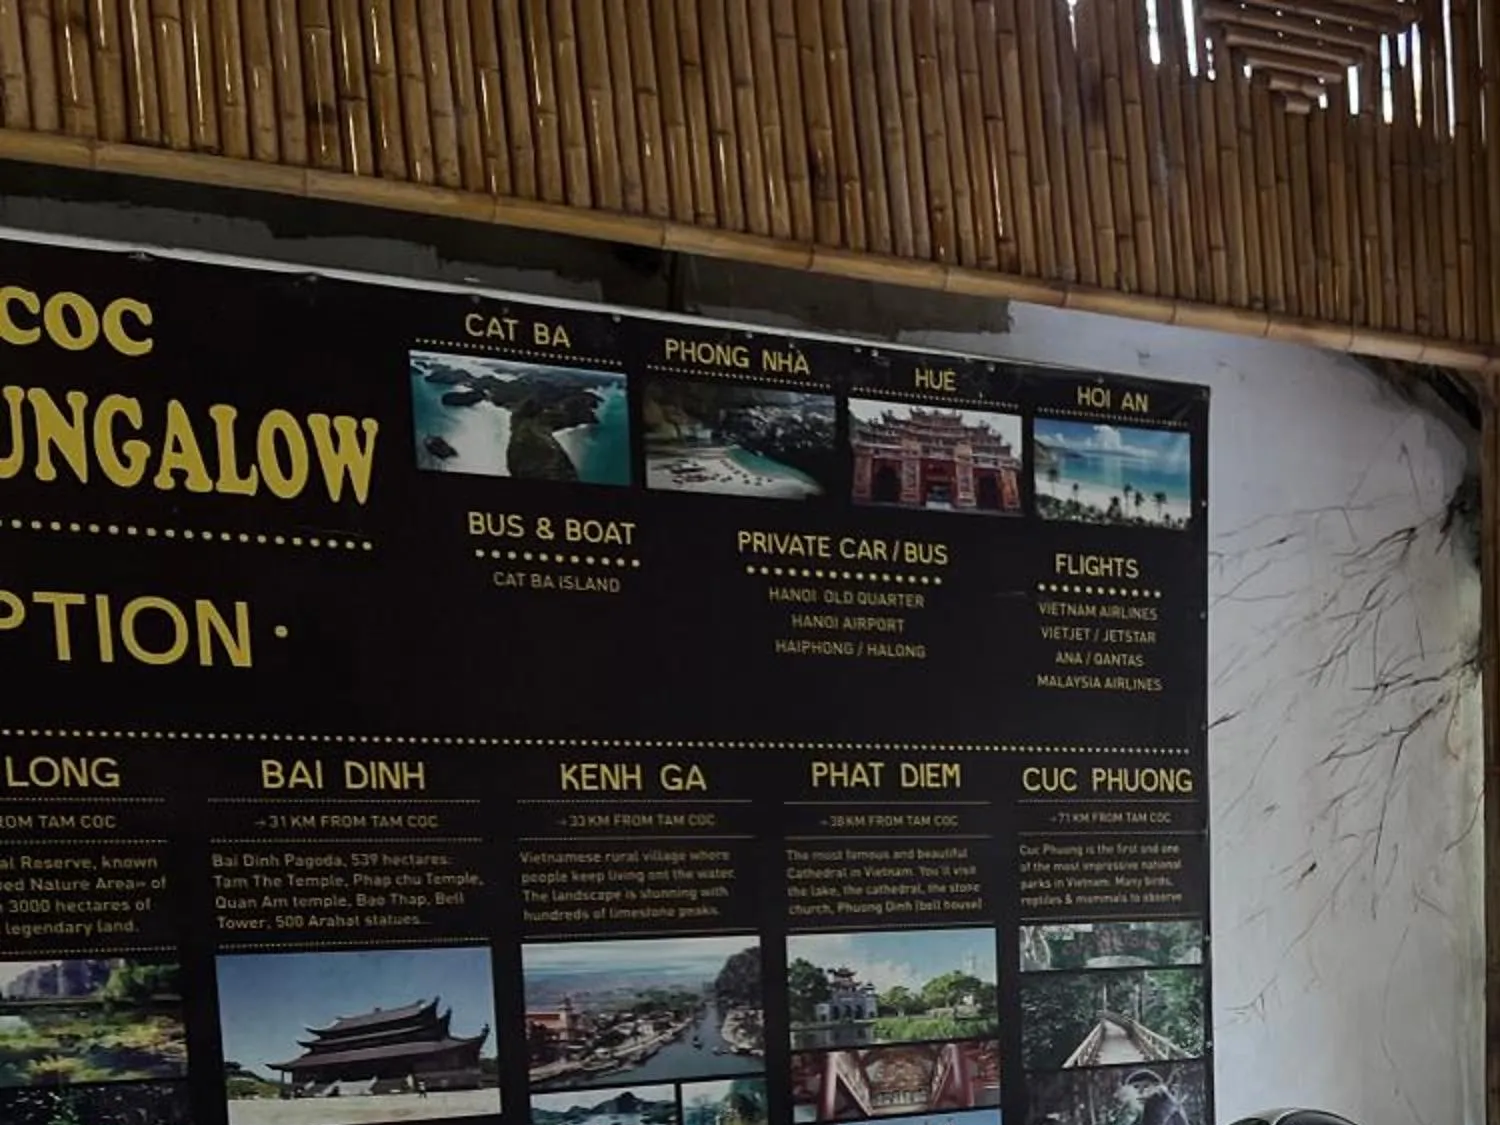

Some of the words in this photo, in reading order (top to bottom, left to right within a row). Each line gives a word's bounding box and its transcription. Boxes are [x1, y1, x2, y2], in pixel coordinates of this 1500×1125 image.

[0, 286, 153, 356] COC
[465, 313, 519, 341] CAT
[533, 322, 571, 349] BA
[665, 337, 750, 368] PHONG
[1121, 392, 1149, 413] AN
[467, 511, 525, 538] BUS
[535, 516, 555, 541] &
[565, 518, 637, 545] BOAT
[737, 530, 832, 558] PRIVATE
[1055, 553, 1139, 579] FLIGHTS
[493, 571, 527, 587] CAT
[530, 573, 555, 590] BA
[559, 574, 621, 593] ISLAND
[769, 586, 818, 603] HANOI
[824, 588, 852, 605] OLD
[857, 591, 926, 608] QUARTER
[1039, 602, 1096, 618] VIETNAM
[1100, 604, 1158, 621] AIRLINES
[792, 613, 839, 630] HANOI
[843, 615, 905, 633] AIRPORT
[1041, 627, 1090, 641] VIETJET
[1102, 629, 1156, 644] JETSTAR
[775, 640, 856, 657] HAIPHONG
[867, 643, 928, 660] HALONG
[1094, 652, 1144, 667] QANTAS
[1037, 673, 1102, 689] MALAYSIA
[1104, 675, 1163, 692] AIRLINES
[5, 755, 120, 788] LONG
[261, 759, 323, 790] BAI
[344, 760, 425, 791] DINH
[560, 763, 642, 791] KENH
[660, 763, 708, 792] GA
[811, 761, 885, 789] PHAT
[900, 762, 961, 789] DIEM
[1023, 767, 1079, 792] CUC
[1091, 767, 1193, 793] PHUONG
[38, 814, 75, 829] TAM
[80, 814, 118, 830] COC
[291, 815, 315, 830] KM
[320, 815, 367, 829] FROM
[370, 815, 403, 828] TAM
[407, 815, 438, 829] COC
[588, 814, 610, 828] KM
[613, 814, 653, 828] FROM
[657, 813, 685, 827] TAM
[688, 813, 716, 827] COC
[846, 814, 866, 828] KM
[868, 814, 903, 828] FROM
[907, 814, 931, 827] TAM
[934, 815, 960, 828] COC
[1127, 811, 1147, 823] TAM
[101, 855, 158, 869] known
[211, 853, 239, 868] Bai
[243, 853, 280, 867] Dinh
[30, 877, 91, 892] Nature
[151, 875, 167, 890] of
[253, 874, 283, 888] The
[55, 899, 131, 912] hectares
[135, 897, 152, 911] of
[261, 895, 289, 909] Am
[5, 920, 93, 939] legendary
[275, 915, 304, 929] 500
